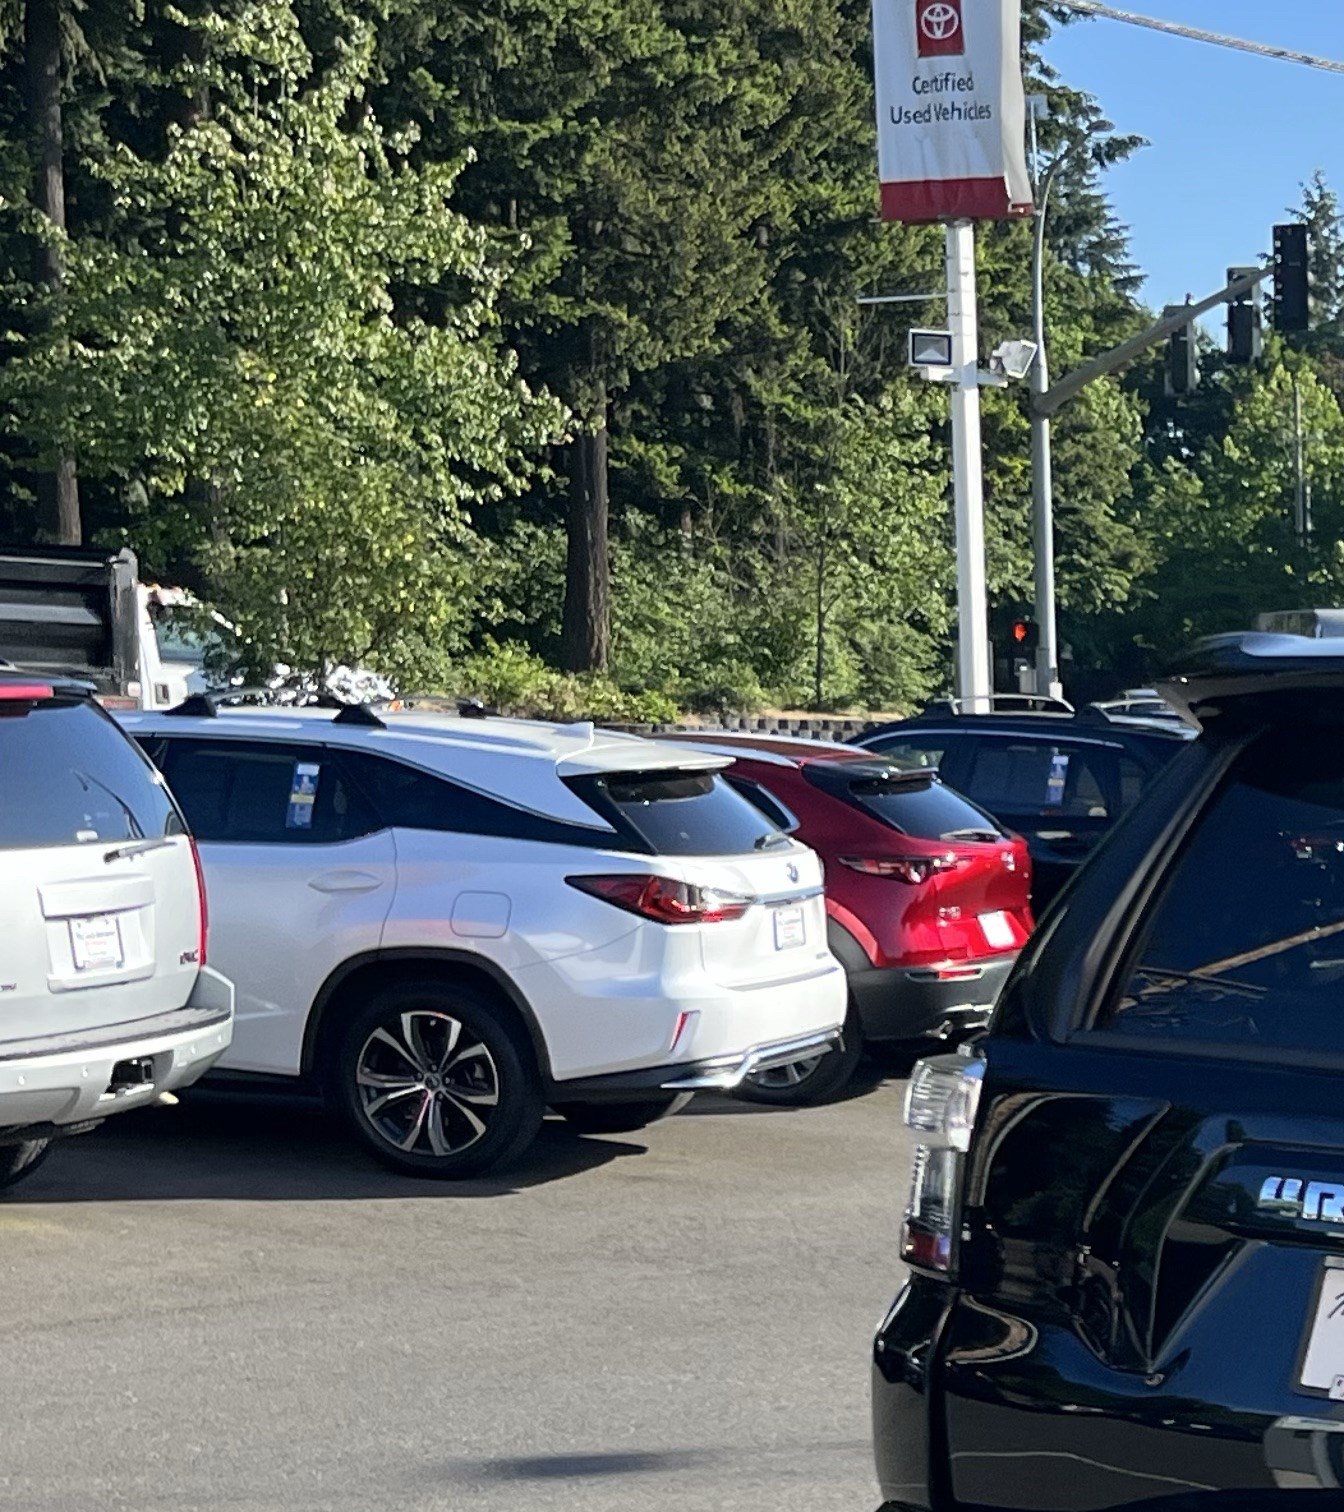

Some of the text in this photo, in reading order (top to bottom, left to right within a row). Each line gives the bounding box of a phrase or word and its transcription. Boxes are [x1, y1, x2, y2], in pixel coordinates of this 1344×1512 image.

[911, 71, 975, 95] Certified
[889, 100, 992, 125] Used Vehicles
